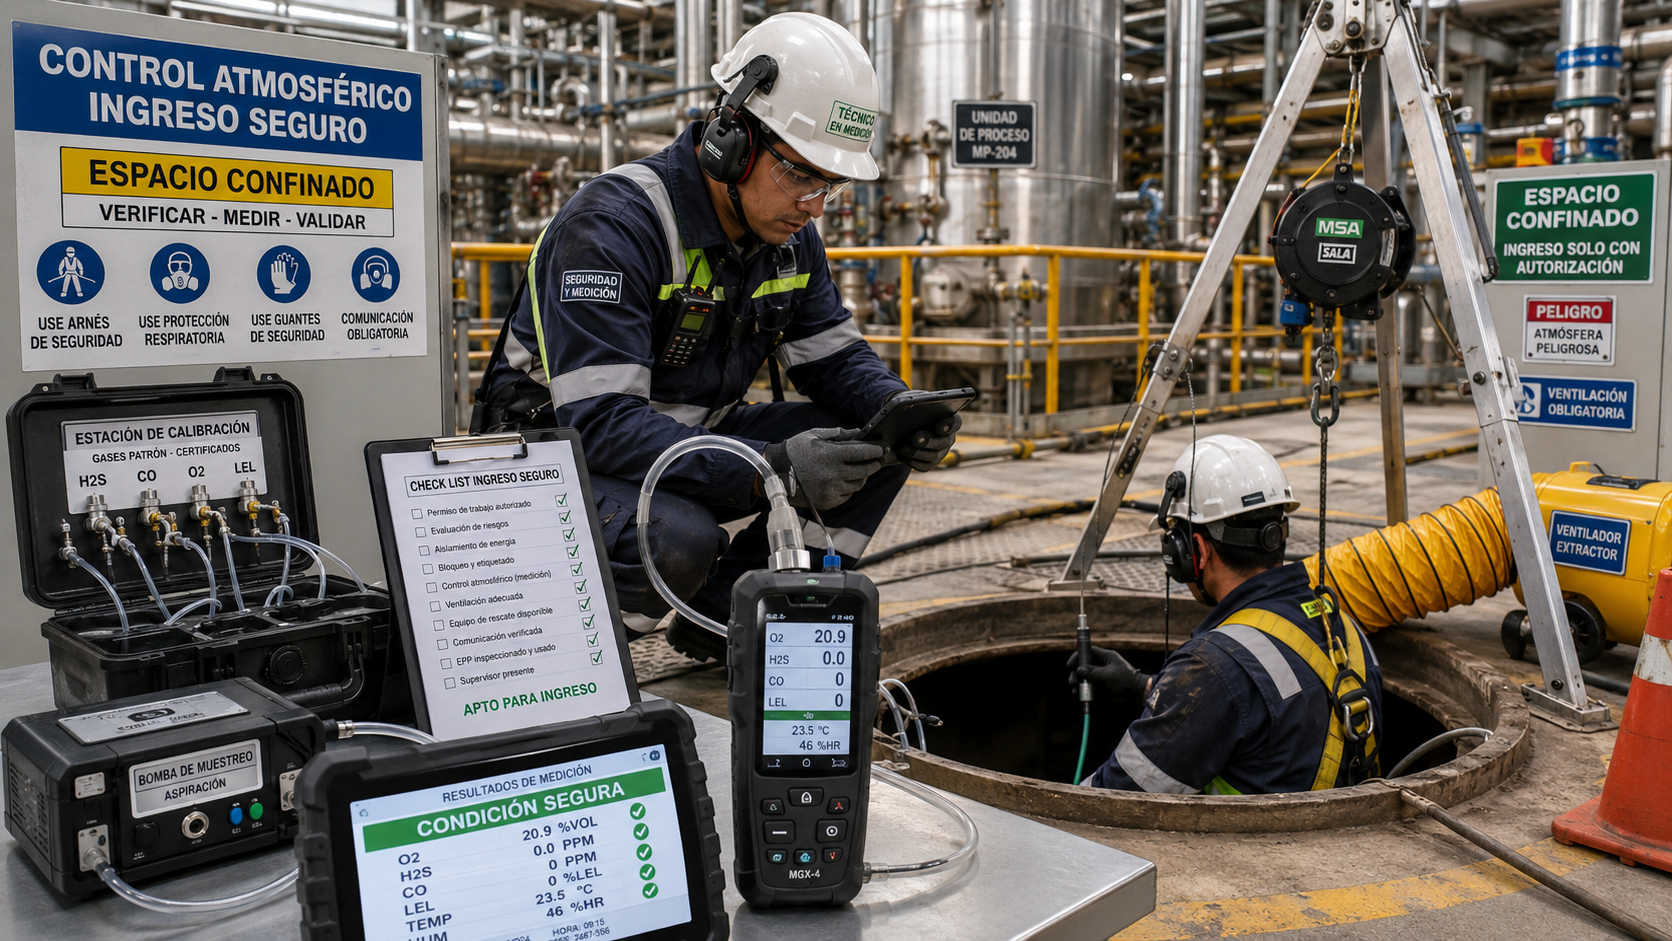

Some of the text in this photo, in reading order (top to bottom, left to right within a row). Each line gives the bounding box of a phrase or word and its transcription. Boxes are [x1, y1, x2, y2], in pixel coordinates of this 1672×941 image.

[39, 43, 412, 112] CONTROL ATMOSFÉRICO
[89, 92, 367, 144] INGRESO SEGURO
[839, 106, 874, 126] TÉCNICO
[972, 110, 1018, 124] UNIDAD
[960, 128, 1030, 142] DE PROCESO
[972, 145, 1017, 159] MP-204
[89, 160, 375, 200] ESPACIO CONFINADO
[1524, 184, 1620, 206] ESPACIO
[99, 203, 206, 225] VERIFICAR
[223, 209, 280, 227] MEDIR
[296, 212, 366, 230] VALIDAR
[1506, 208, 1639, 229] CONFINADO
[1318, 220, 1360, 236] MSA
[1322, 247, 1350, 260] SALA
[1504, 241, 1640, 256] INGRESO SOLO CON
[1516, 257, 1624, 274] AUTORIZACIÓN
[566, 274, 618, 286] SEGURIDAD
[564, 286, 616, 299] Y MEDICIÓN
[139, 312, 230, 328] USE PROTECCIÓN
[251, 313, 321, 326] USE GUANTES
[341, 309, 414, 324] COMUNICACIÓN
[1536, 304, 1603, 320] PELIGRO
[38, 313, 110, 330] USE ARNÉS
[30, 334, 123, 349] DE SEGURIDAD
[145, 331, 225, 346] RESPIRATORIA
[250, 329, 325, 343] DE SEGURIDAD
[347, 327, 409, 341] OBLIGATORIA
[1534, 326, 1603, 340] ATMÓSFERA
[1536, 343, 1600, 355] PELIGROSA
[1548, 388, 1628, 403] VENTILACIÓN
[1548, 404, 1626, 420] OBLIGATORIA
[75, 419, 250, 445] ESTACIÓN DE CALIBRACIÓN
[92, 451, 126, 464] GASES
[129, 447, 167, 461] PATRÓN
[176, 443, 241, 457] CERTIFICADOS
[79, 461, 256, 488] H2S CO O2 LEL
[410, 469, 559, 492] CHECK LIST INGRESO SEGURO
[427, 500, 531, 517] Permiso de trabajo autorizado
[431, 520, 509, 535] Evaluación de riesgos
[1556, 524, 1622, 544] VENTILADOR
[434, 542, 477, 553] Aislamiento
[479, 540, 488, 549] de
[1556, 541, 1618, 561] EXTRACTOR
[438, 557, 514, 573] Bloqueo y etiquetado
[442, 570, 552, 590] Control atmosférico (medición)
[445, 592, 524, 609] Ventilación adecuada
[450, 607, 553, 628] Equipo de rescate disponible
[452, 627, 542, 646] Comunicación verificada
[770, 629, 846, 643] O2 20.9
[456, 644, 556, 666] EPP inspeccionado y usado
[770, 651, 844, 665] H2S 0.0
[460, 667, 534, 686] Supervisor presente
[769, 672, 844, 686] CO 0
[464, 682, 597, 716] APTO PARA INGRESO
[768, 693, 843, 707] LEL 0
[792, 726, 830, 735] 23.5 °C
[799, 740, 840, 750] 46 %HR
[139, 751, 253, 786] BOMBA DE MUESTREO
[164, 778, 226, 801] ASPIRACIÓN
[443, 764, 592, 802] RESULTADOS DE MEDICIÓN
[417, 782, 625, 837] CONDICIÓN SEGURA
[398, 816, 598, 865] O2 20.9 %VOL
[400, 834, 594, 882] H2S 0.0 PPM
[402, 851, 596, 898] CO 0 PPM
[789, 870, 820, 879] MGX-4
[404, 867, 602, 916] LEL 0 %LEL
[406, 884, 593, 932] TEMP 23.5 °C
[408, 896, 604, 941] UM 46 %HR
[552, 925, 581, 936] HORA:
